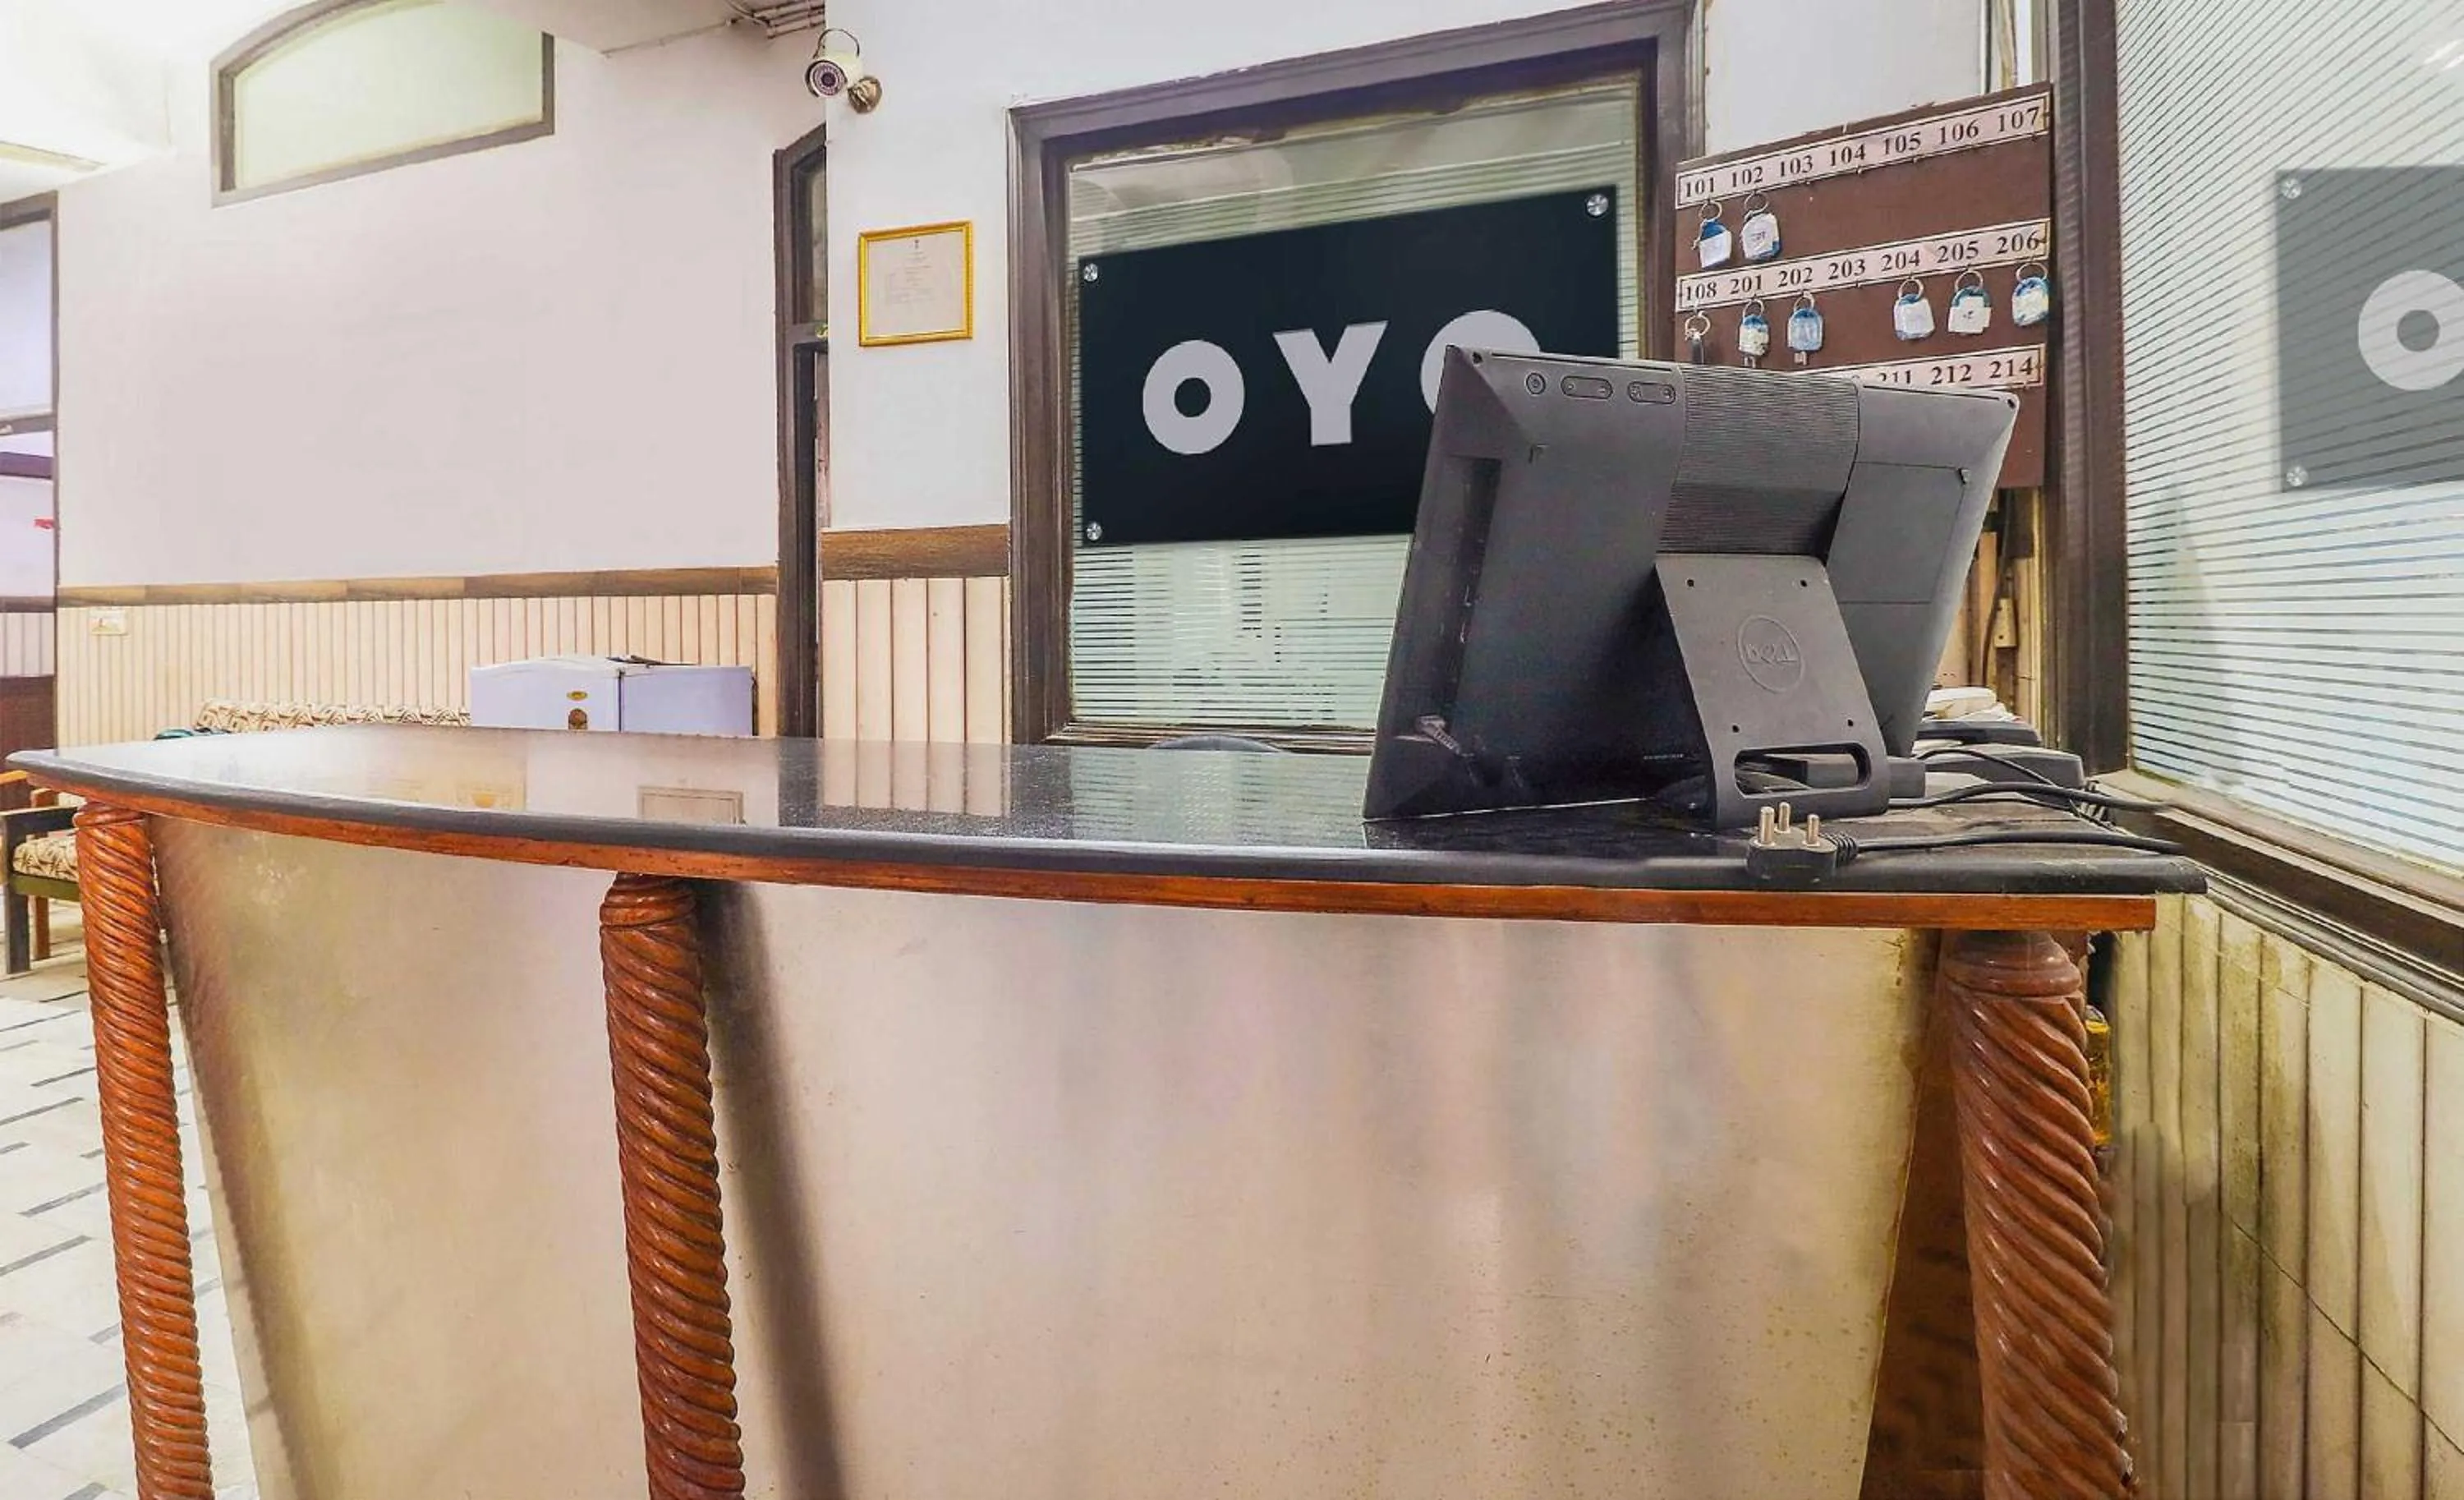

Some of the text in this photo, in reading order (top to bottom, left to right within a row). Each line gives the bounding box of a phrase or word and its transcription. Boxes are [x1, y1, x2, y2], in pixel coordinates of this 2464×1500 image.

[1686, 106, 2040, 198] 101 102 103 104 105 106 107
[1686, 229, 2039, 301] 108 201 202 203 204 205 206
[1930, 364, 1972, 385] 212
[1989, 357, 2034, 379] 214
